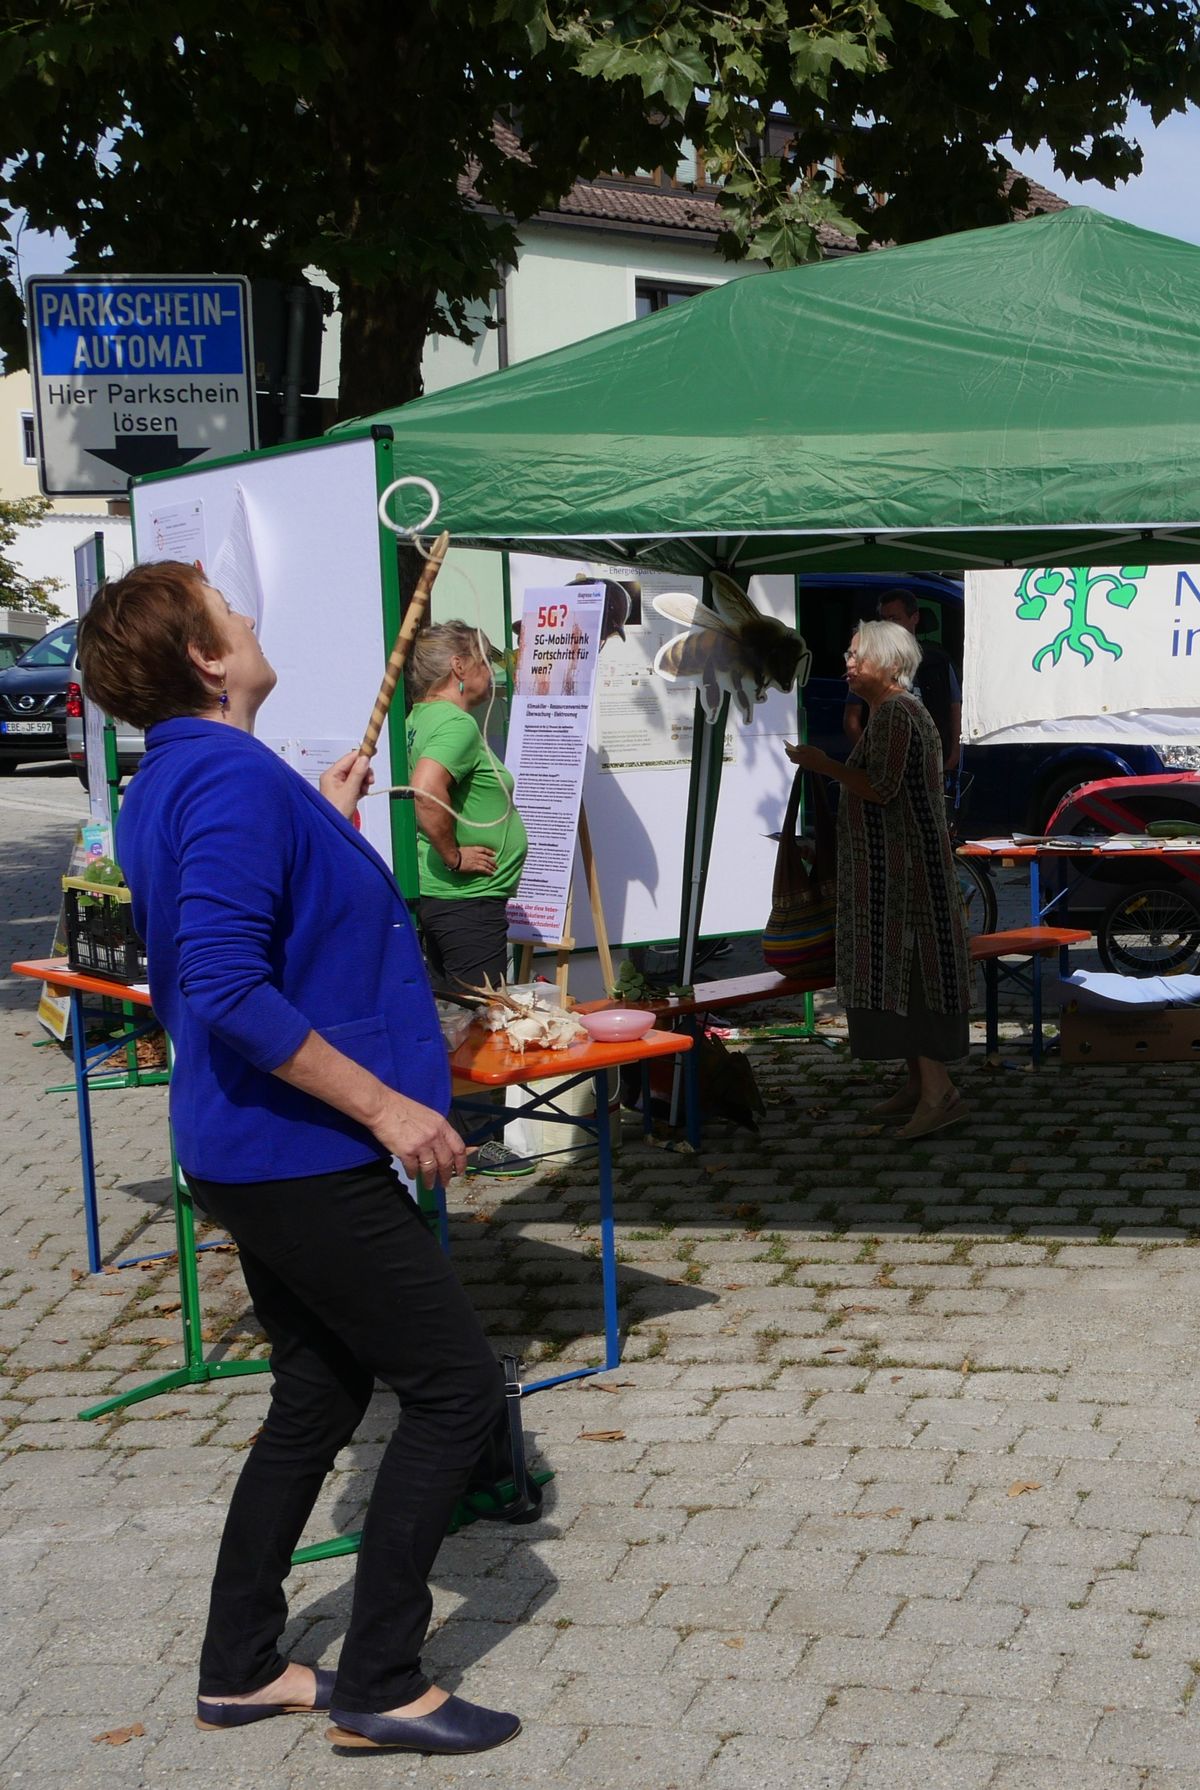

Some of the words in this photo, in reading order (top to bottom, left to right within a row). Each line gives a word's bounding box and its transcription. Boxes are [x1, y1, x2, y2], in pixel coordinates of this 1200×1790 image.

[41, 293, 236, 327] PARKSCHEIN-
[74, 335, 206, 368] AUTOMAT
[49, 384, 98, 405] Hier
[108, 382, 239, 404] Parkschein
[114, 412, 178, 432] lösen
[537, 604, 568, 628] 5G?
[534, 633, 589, 645] 5G-Mobilfunk
[533, 649, 575, 660] Fortschritt
[577, 649, 589, 660] für
[531, 663, 552, 674] wen?
[37, 723, 51, 731] 597
